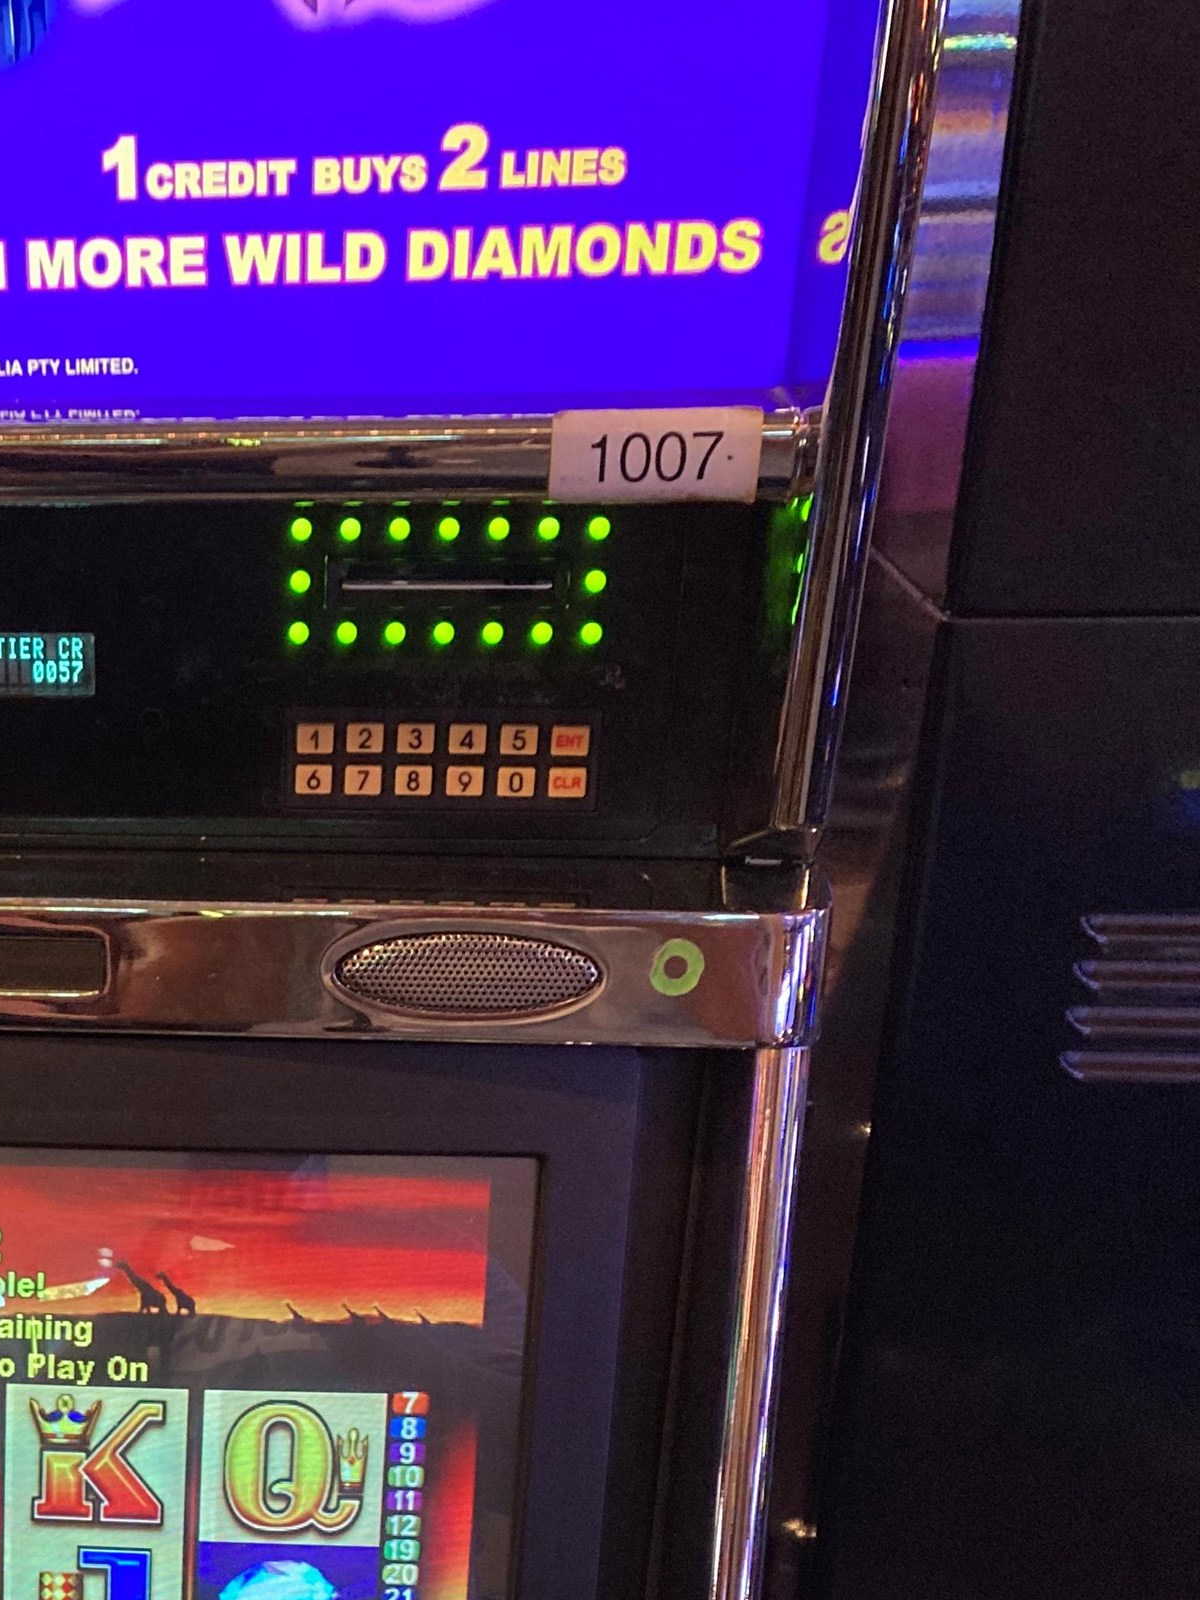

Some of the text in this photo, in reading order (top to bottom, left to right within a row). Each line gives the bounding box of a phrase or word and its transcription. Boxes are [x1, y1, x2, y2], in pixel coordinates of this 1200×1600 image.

[101, 123, 627, 201] 1 CREDIT BUYS 2 LINES
[28, 233, 206, 290] MORE
[225, 229, 387, 287] WILD
[406, 215, 762, 283] DIAMONDS
[27, 358, 60, 377] PTY
[65, 357, 139, 376] LIMITED.
[591, 431, 724, 482] 1007
[58, 637, 83, 660] CR
[32, 661, 83, 683] 0057
[309, 730, 320, 749] 1
[358, 728, 373, 749] 2
[408, 728, 423, 749] 3
[459, 729, 474, 750] 4
[512, 730, 526, 750] 5
[307, 769, 581, 793] 6 7 8 9 0 CLR
[29, 1353, 95, 1386] Play
[107, 1356, 148, 1382] On
[403, 1391, 419, 1414] 7
[401, 1417, 417, 1440] 8
[31, 1400, 166, 1527] K
[223, 1400, 363, 1536] Q
[394, 1490, 414, 1511] 11
